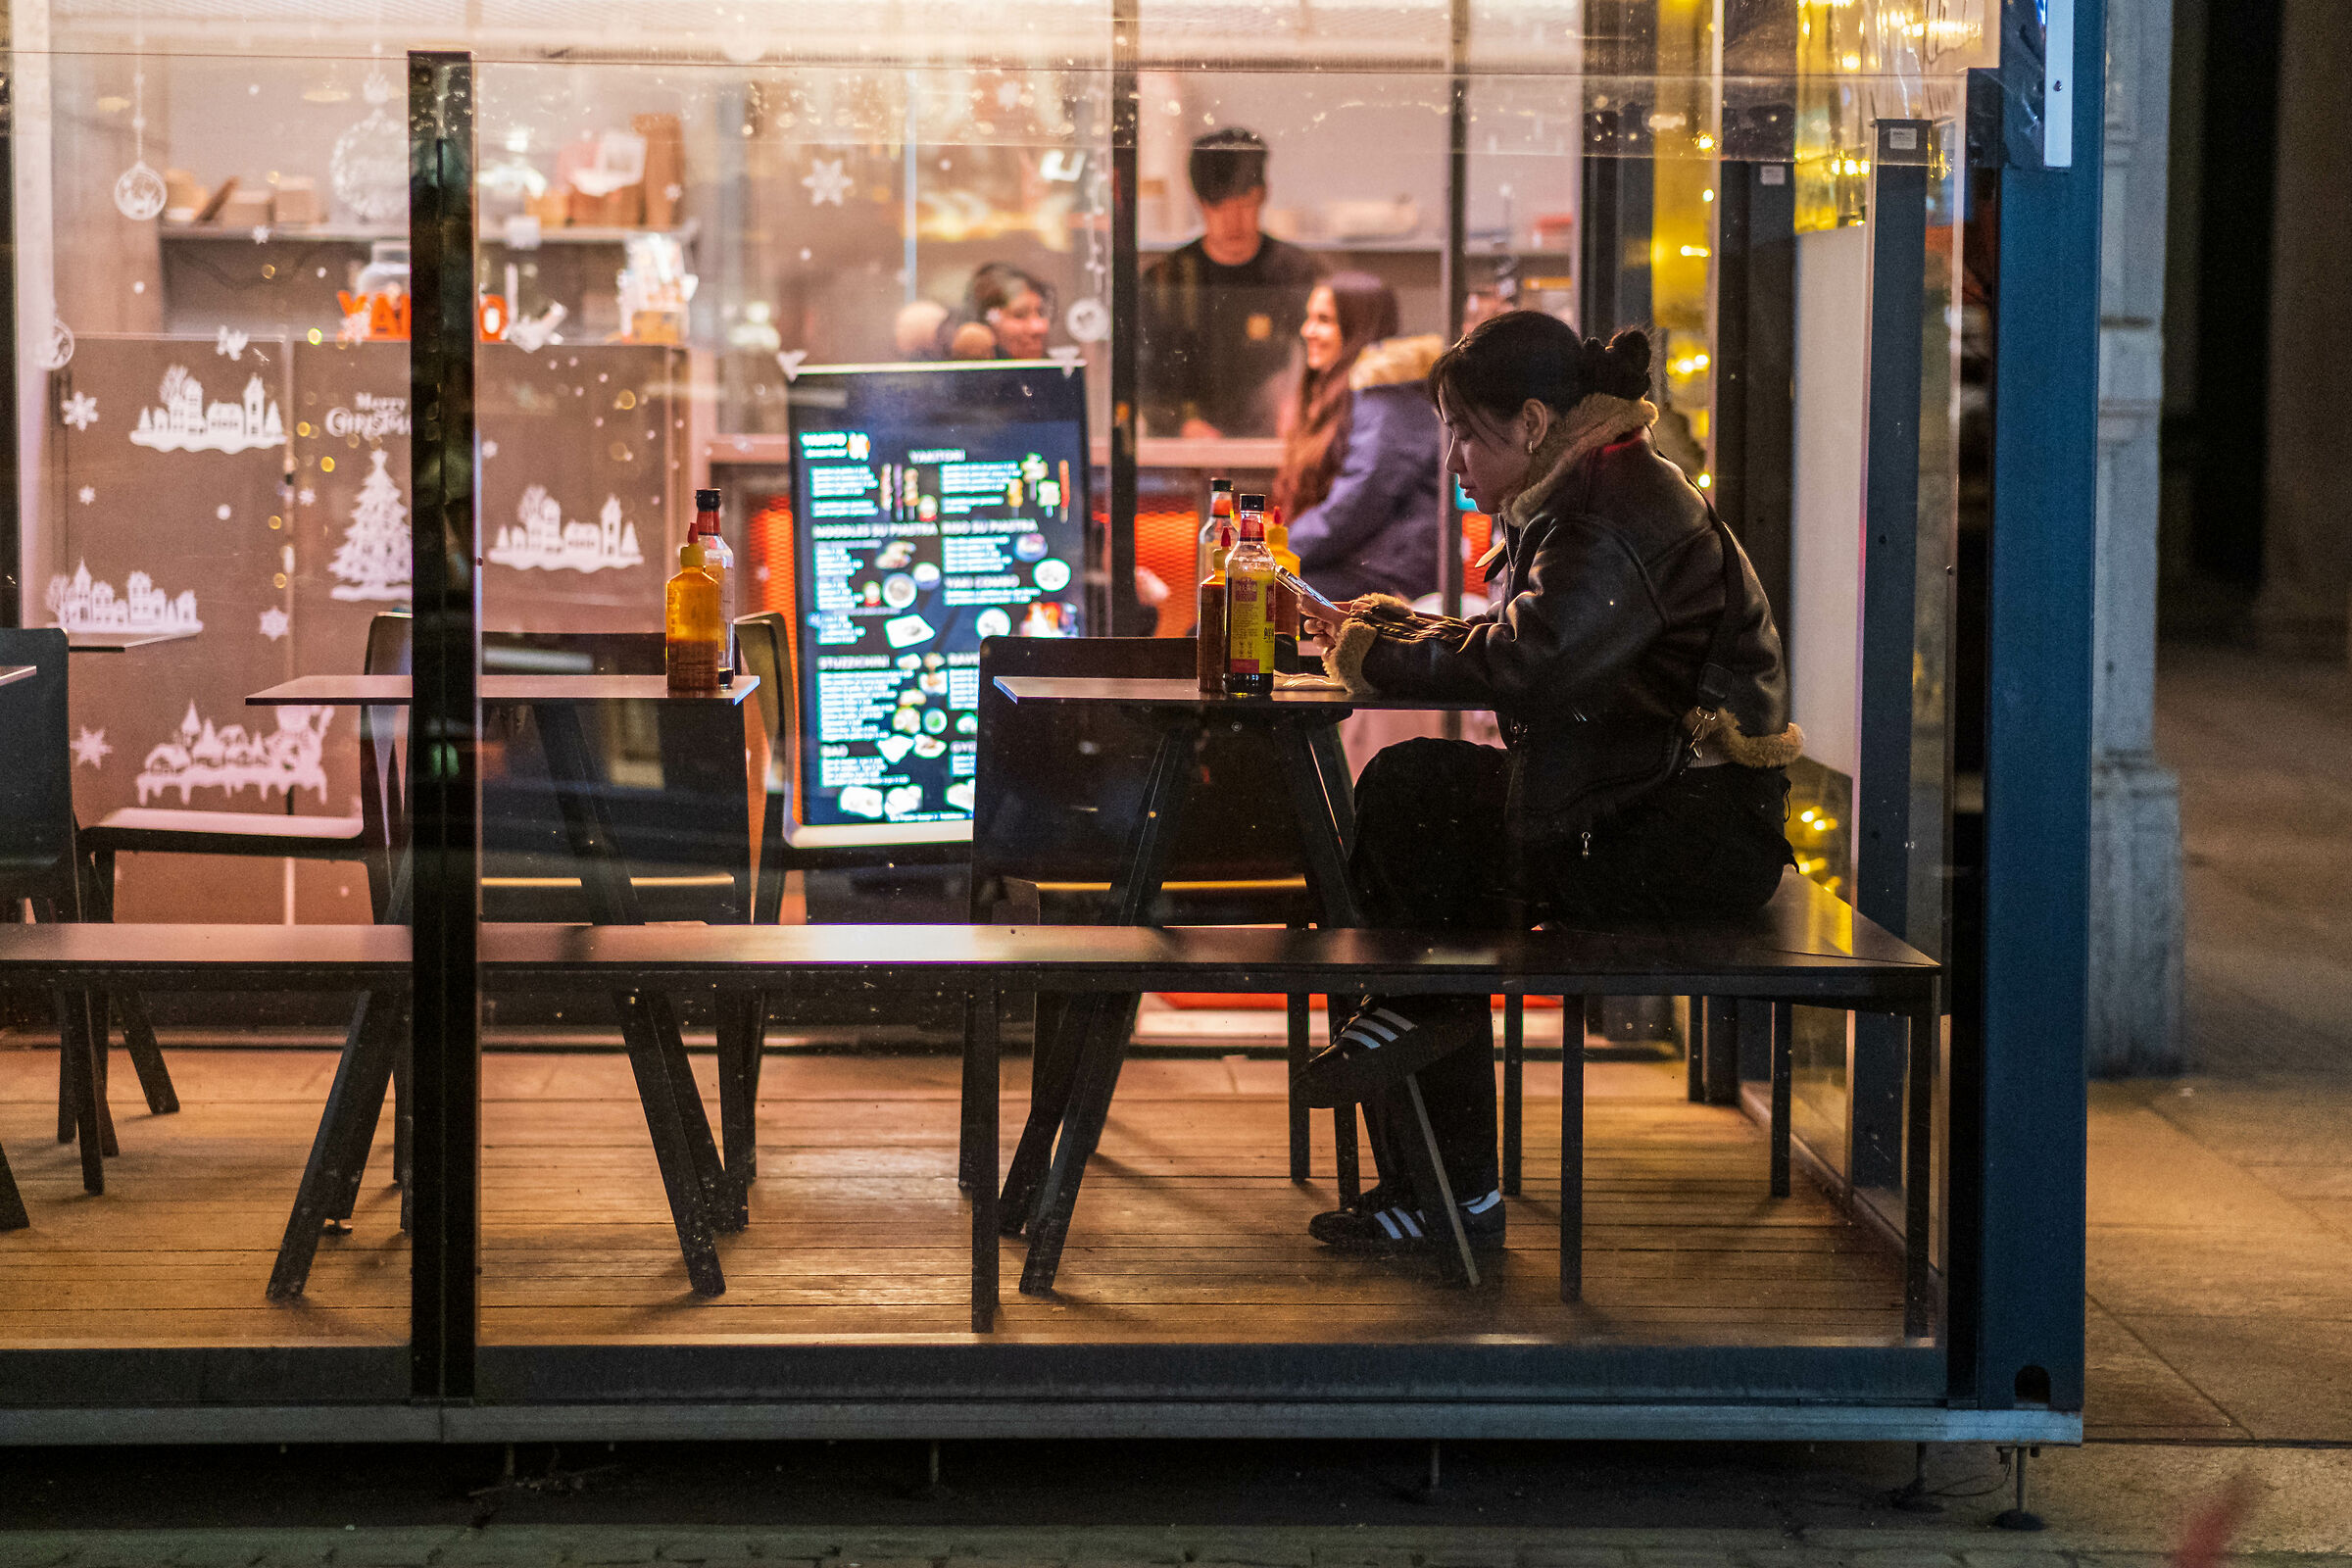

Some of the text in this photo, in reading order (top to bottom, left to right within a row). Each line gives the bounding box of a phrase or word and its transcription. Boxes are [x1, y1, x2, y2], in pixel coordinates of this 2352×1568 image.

[908, 449, 966, 464] YAKITORI
[812, 522, 938, 538] NOODLES SU PIASTRA
[941, 518, 1039, 535] RISO SU PIASTRA
